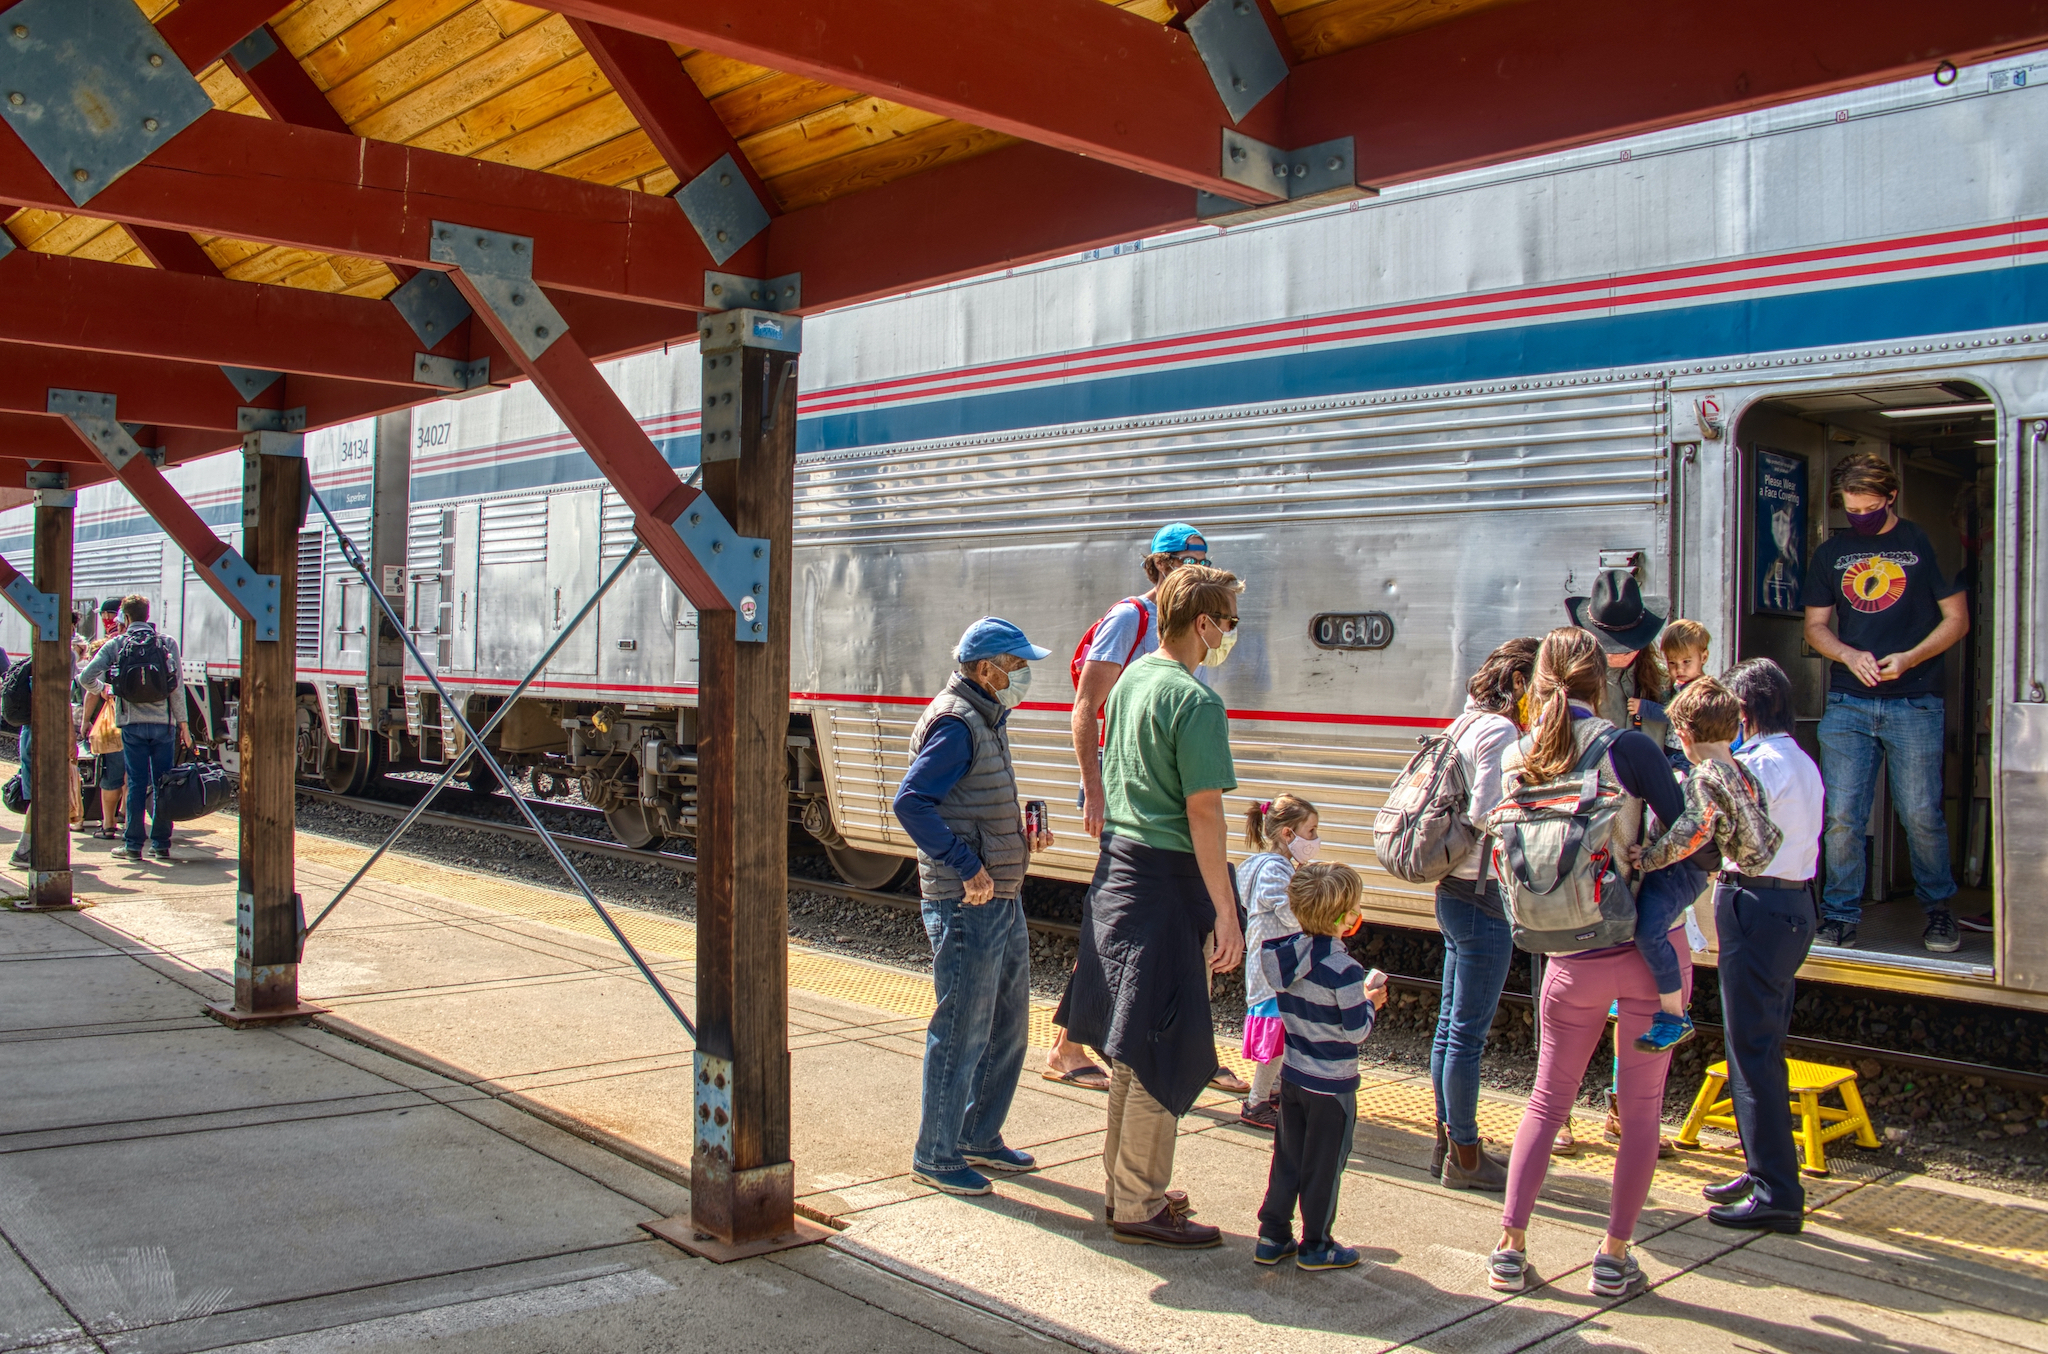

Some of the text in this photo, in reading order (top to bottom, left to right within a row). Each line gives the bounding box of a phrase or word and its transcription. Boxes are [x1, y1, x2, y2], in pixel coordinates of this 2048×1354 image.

[416, 422, 451, 449] 34027
[341, 438, 369, 462] 34134
[1764, 474, 1797, 491] Please Wear
[345, 491, 367, 504] Superliner
[1759, 486, 1800, 507] a Face Covering
